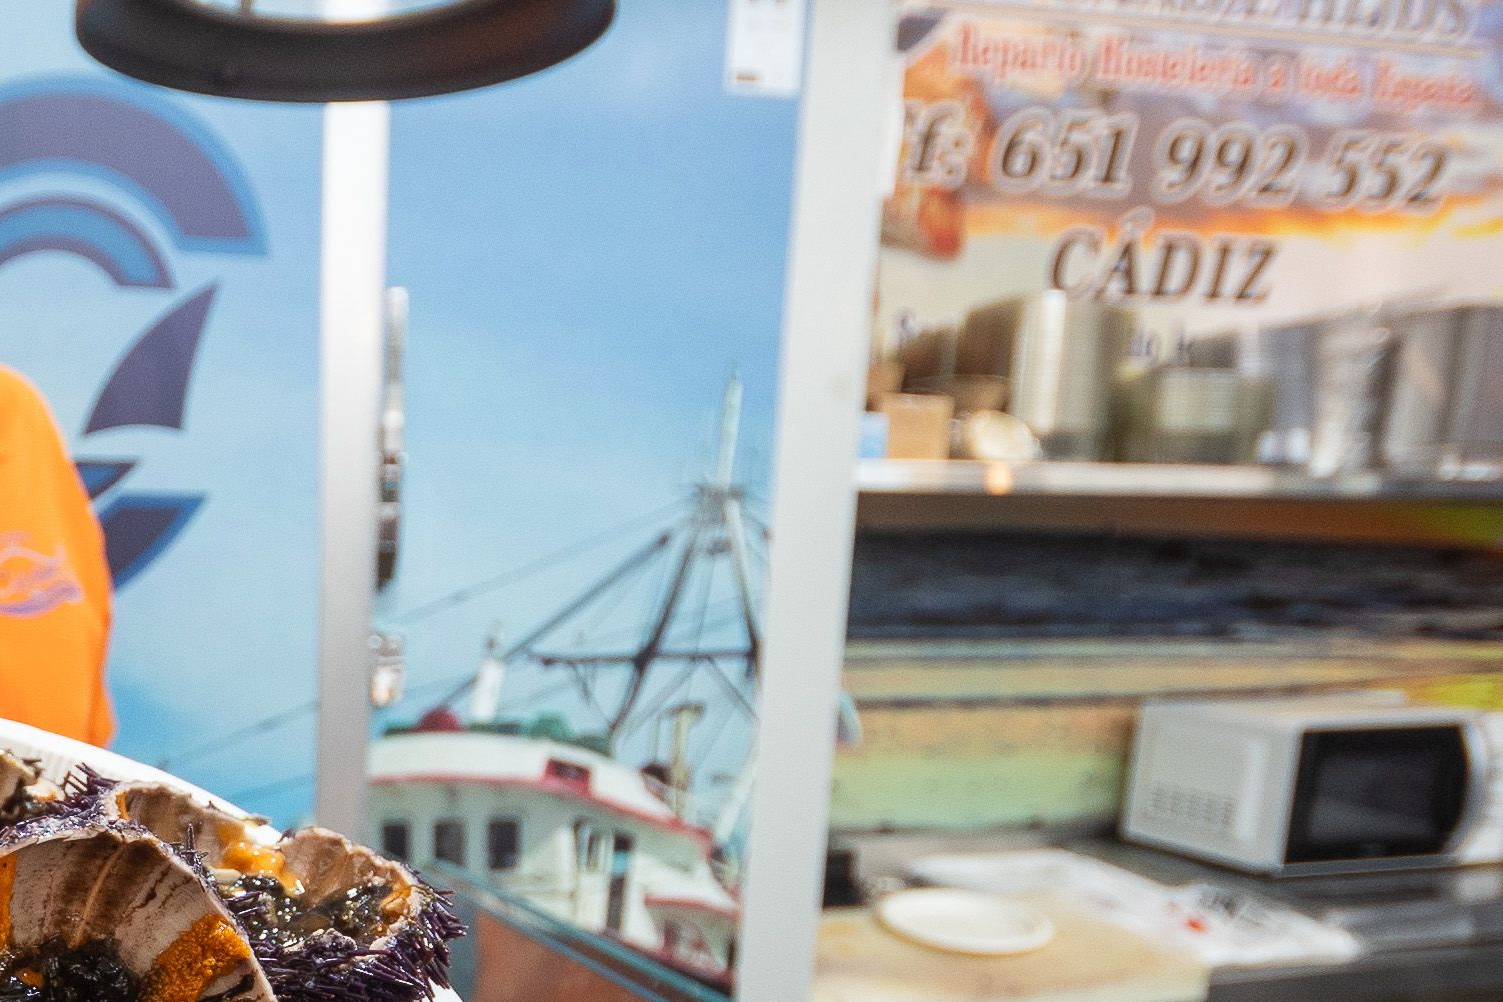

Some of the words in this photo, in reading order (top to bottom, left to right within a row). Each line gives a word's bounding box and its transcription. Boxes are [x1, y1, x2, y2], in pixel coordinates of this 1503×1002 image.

[999, 112, 1129, 187] 651
[1163, 125, 1297, 200] 992
[1325, 138, 1447, 206] 552
